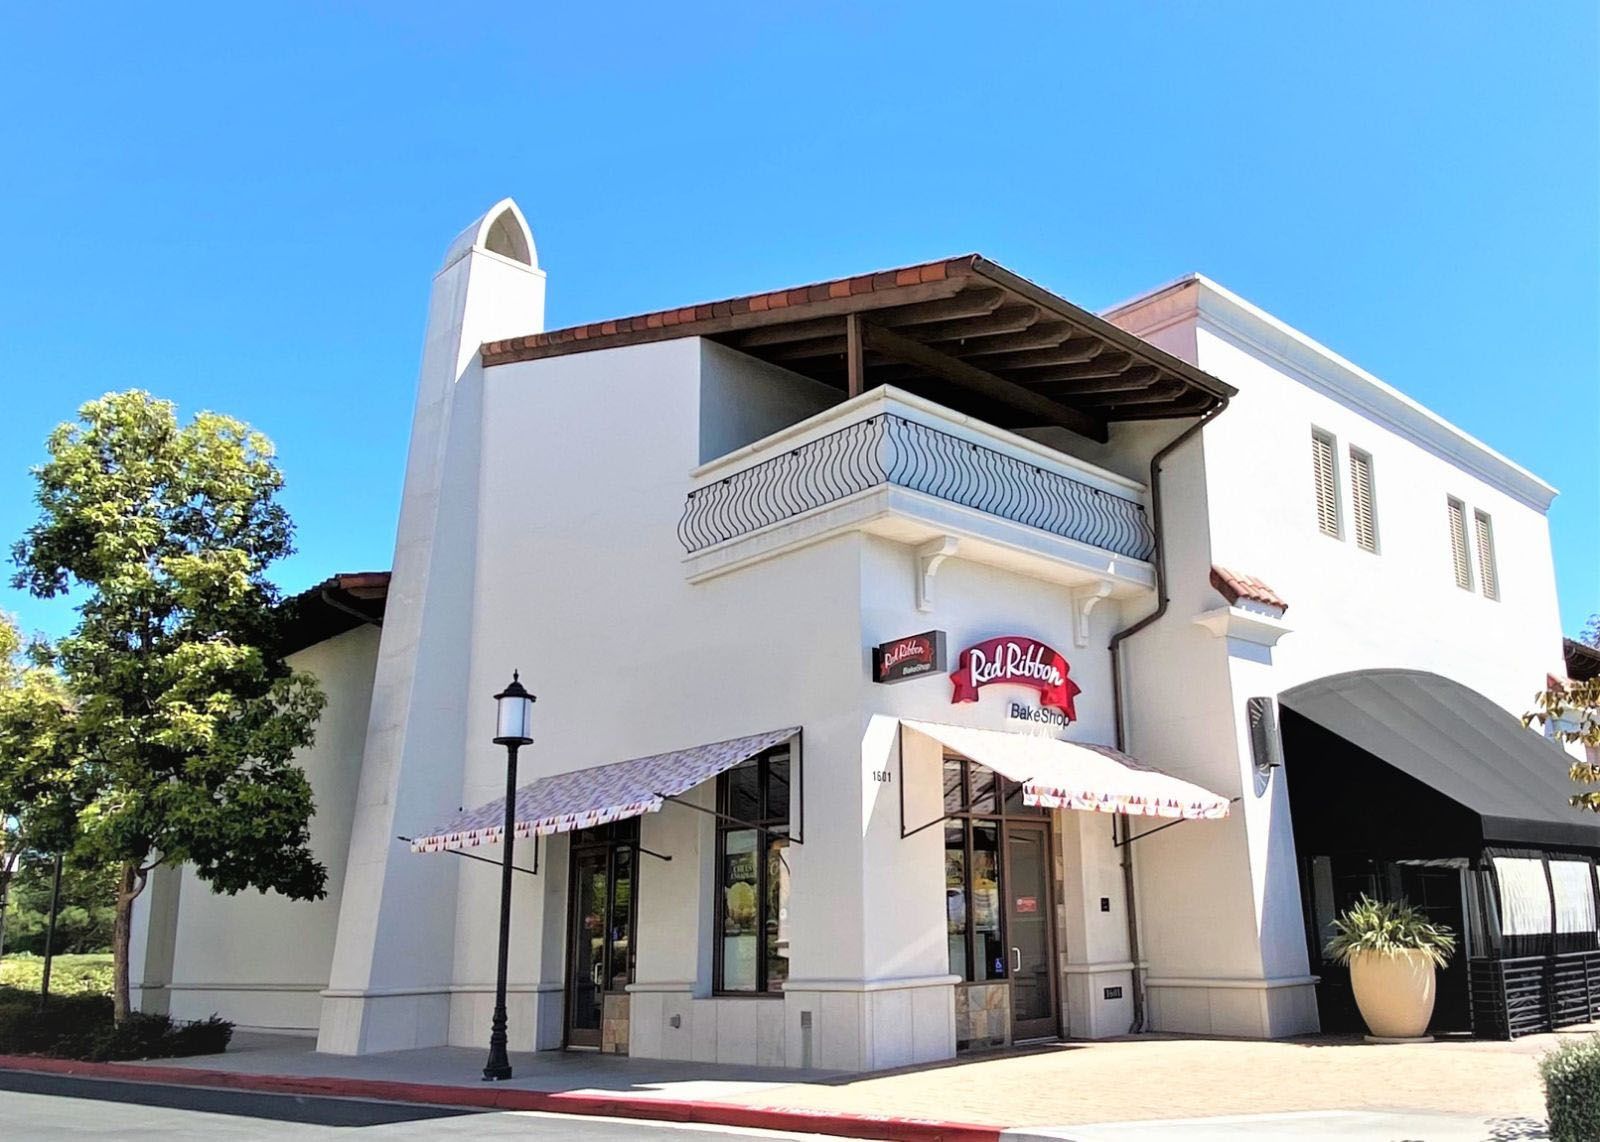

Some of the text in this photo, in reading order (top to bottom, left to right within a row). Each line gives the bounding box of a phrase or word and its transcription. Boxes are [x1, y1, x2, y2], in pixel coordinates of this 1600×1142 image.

[885, 640, 924, 669] Red Ribbon
[970, 642, 1064, 687] Red Ribbon
[1010, 703, 1070, 729] BakeShop
[872, 770, 891, 782] 1601
